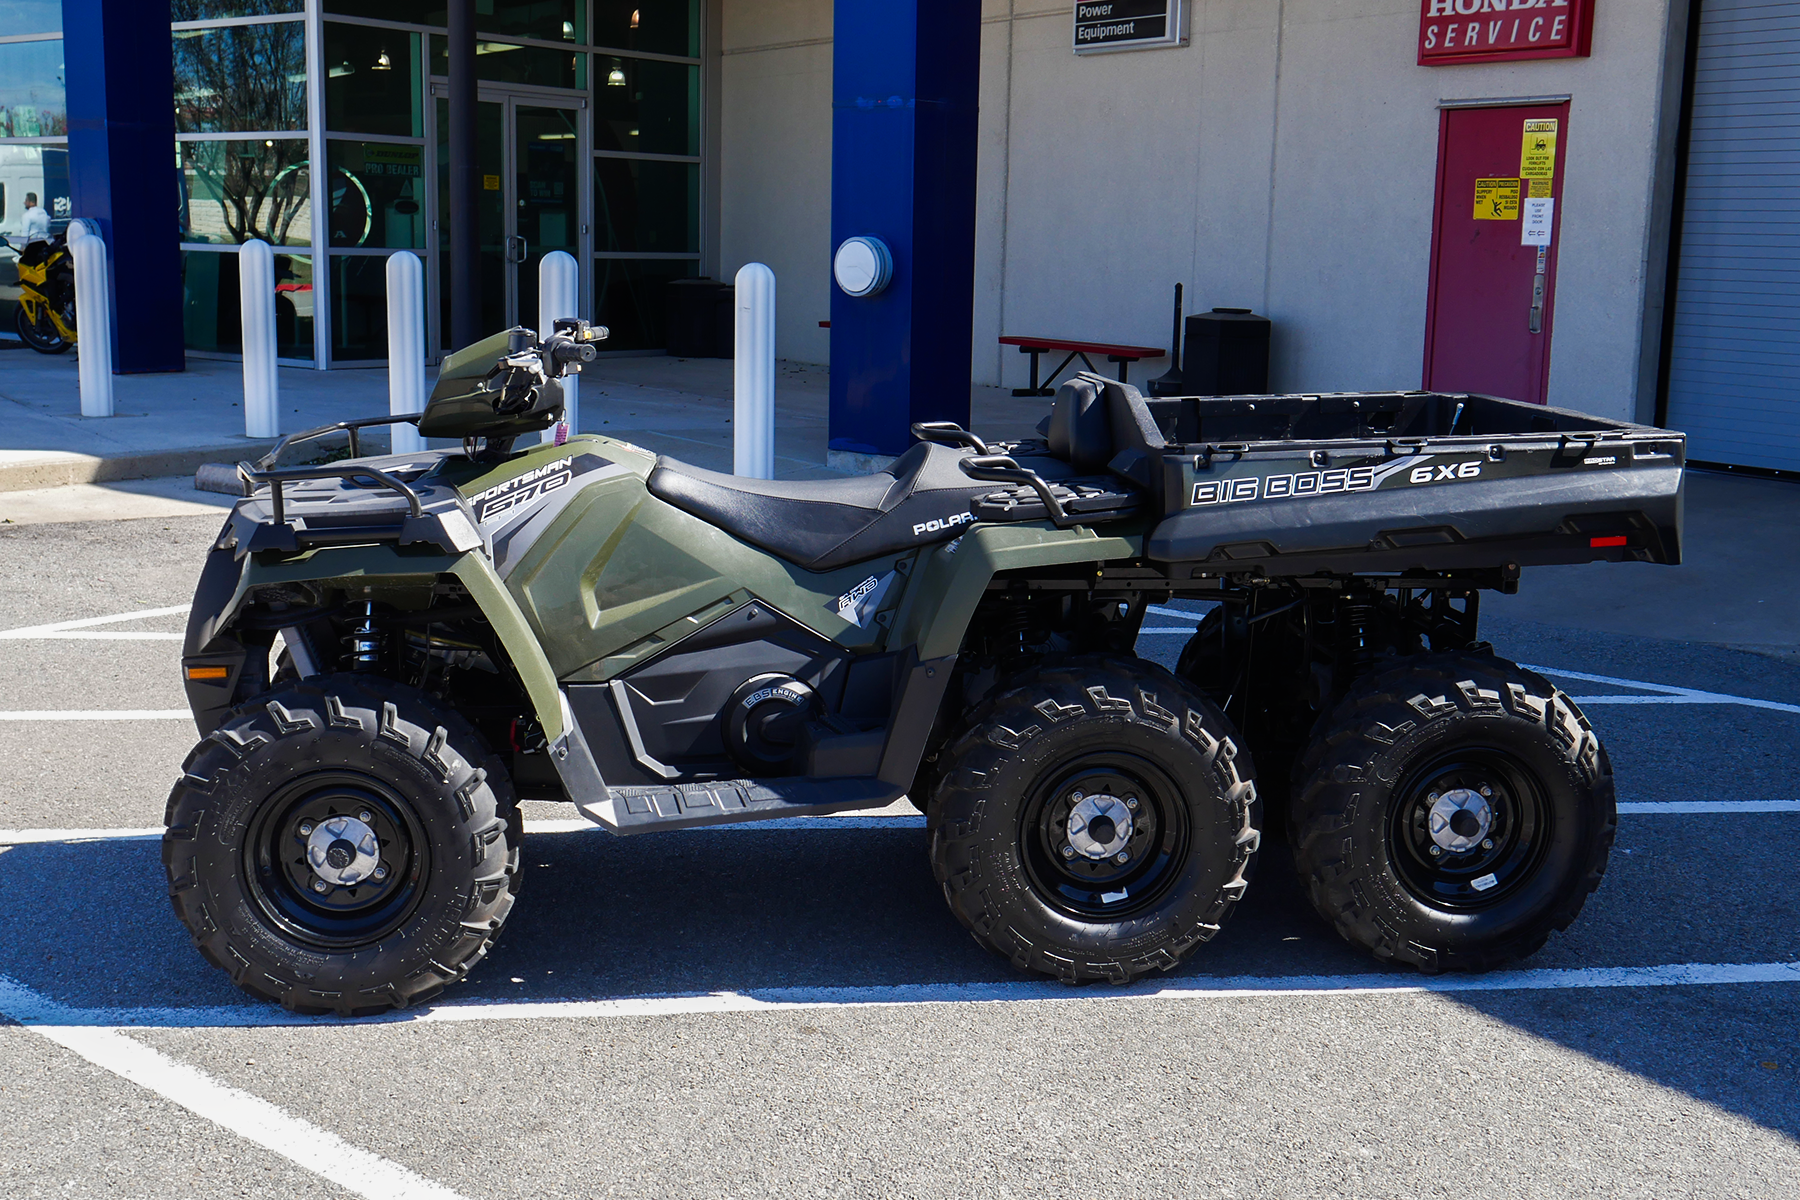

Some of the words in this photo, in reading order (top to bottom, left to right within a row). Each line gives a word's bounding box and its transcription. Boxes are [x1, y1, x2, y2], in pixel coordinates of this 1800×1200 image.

[1079, 4, 1113, 19] Power
[1427, 0, 1567, 17] HON
[1078, 21, 1135, 41] Equipment
[1424, 15, 1567, 49] SERVICE
[1525, 122, 1555, 131] CAUTION
[376, 150, 419, 159] DUNLOP
[365, 162, 384, 174] PRO
[386, 164, 420, 176] DEALER
[465, 455, 573, 507] SPORTSMAN
[1409, 460, 1482, 485] 6X6
[480, 469, 572, 523] 570
[1190, 476, 1260, 506] BIG
[1263, 466, 1376, 499] BOSS
[912, 511, 978, 536] POLAR
[838, 578, 878, 612] AWD
[745, 689, 770, 706] EBS
[772, 688, 801, 703] ENGINE
